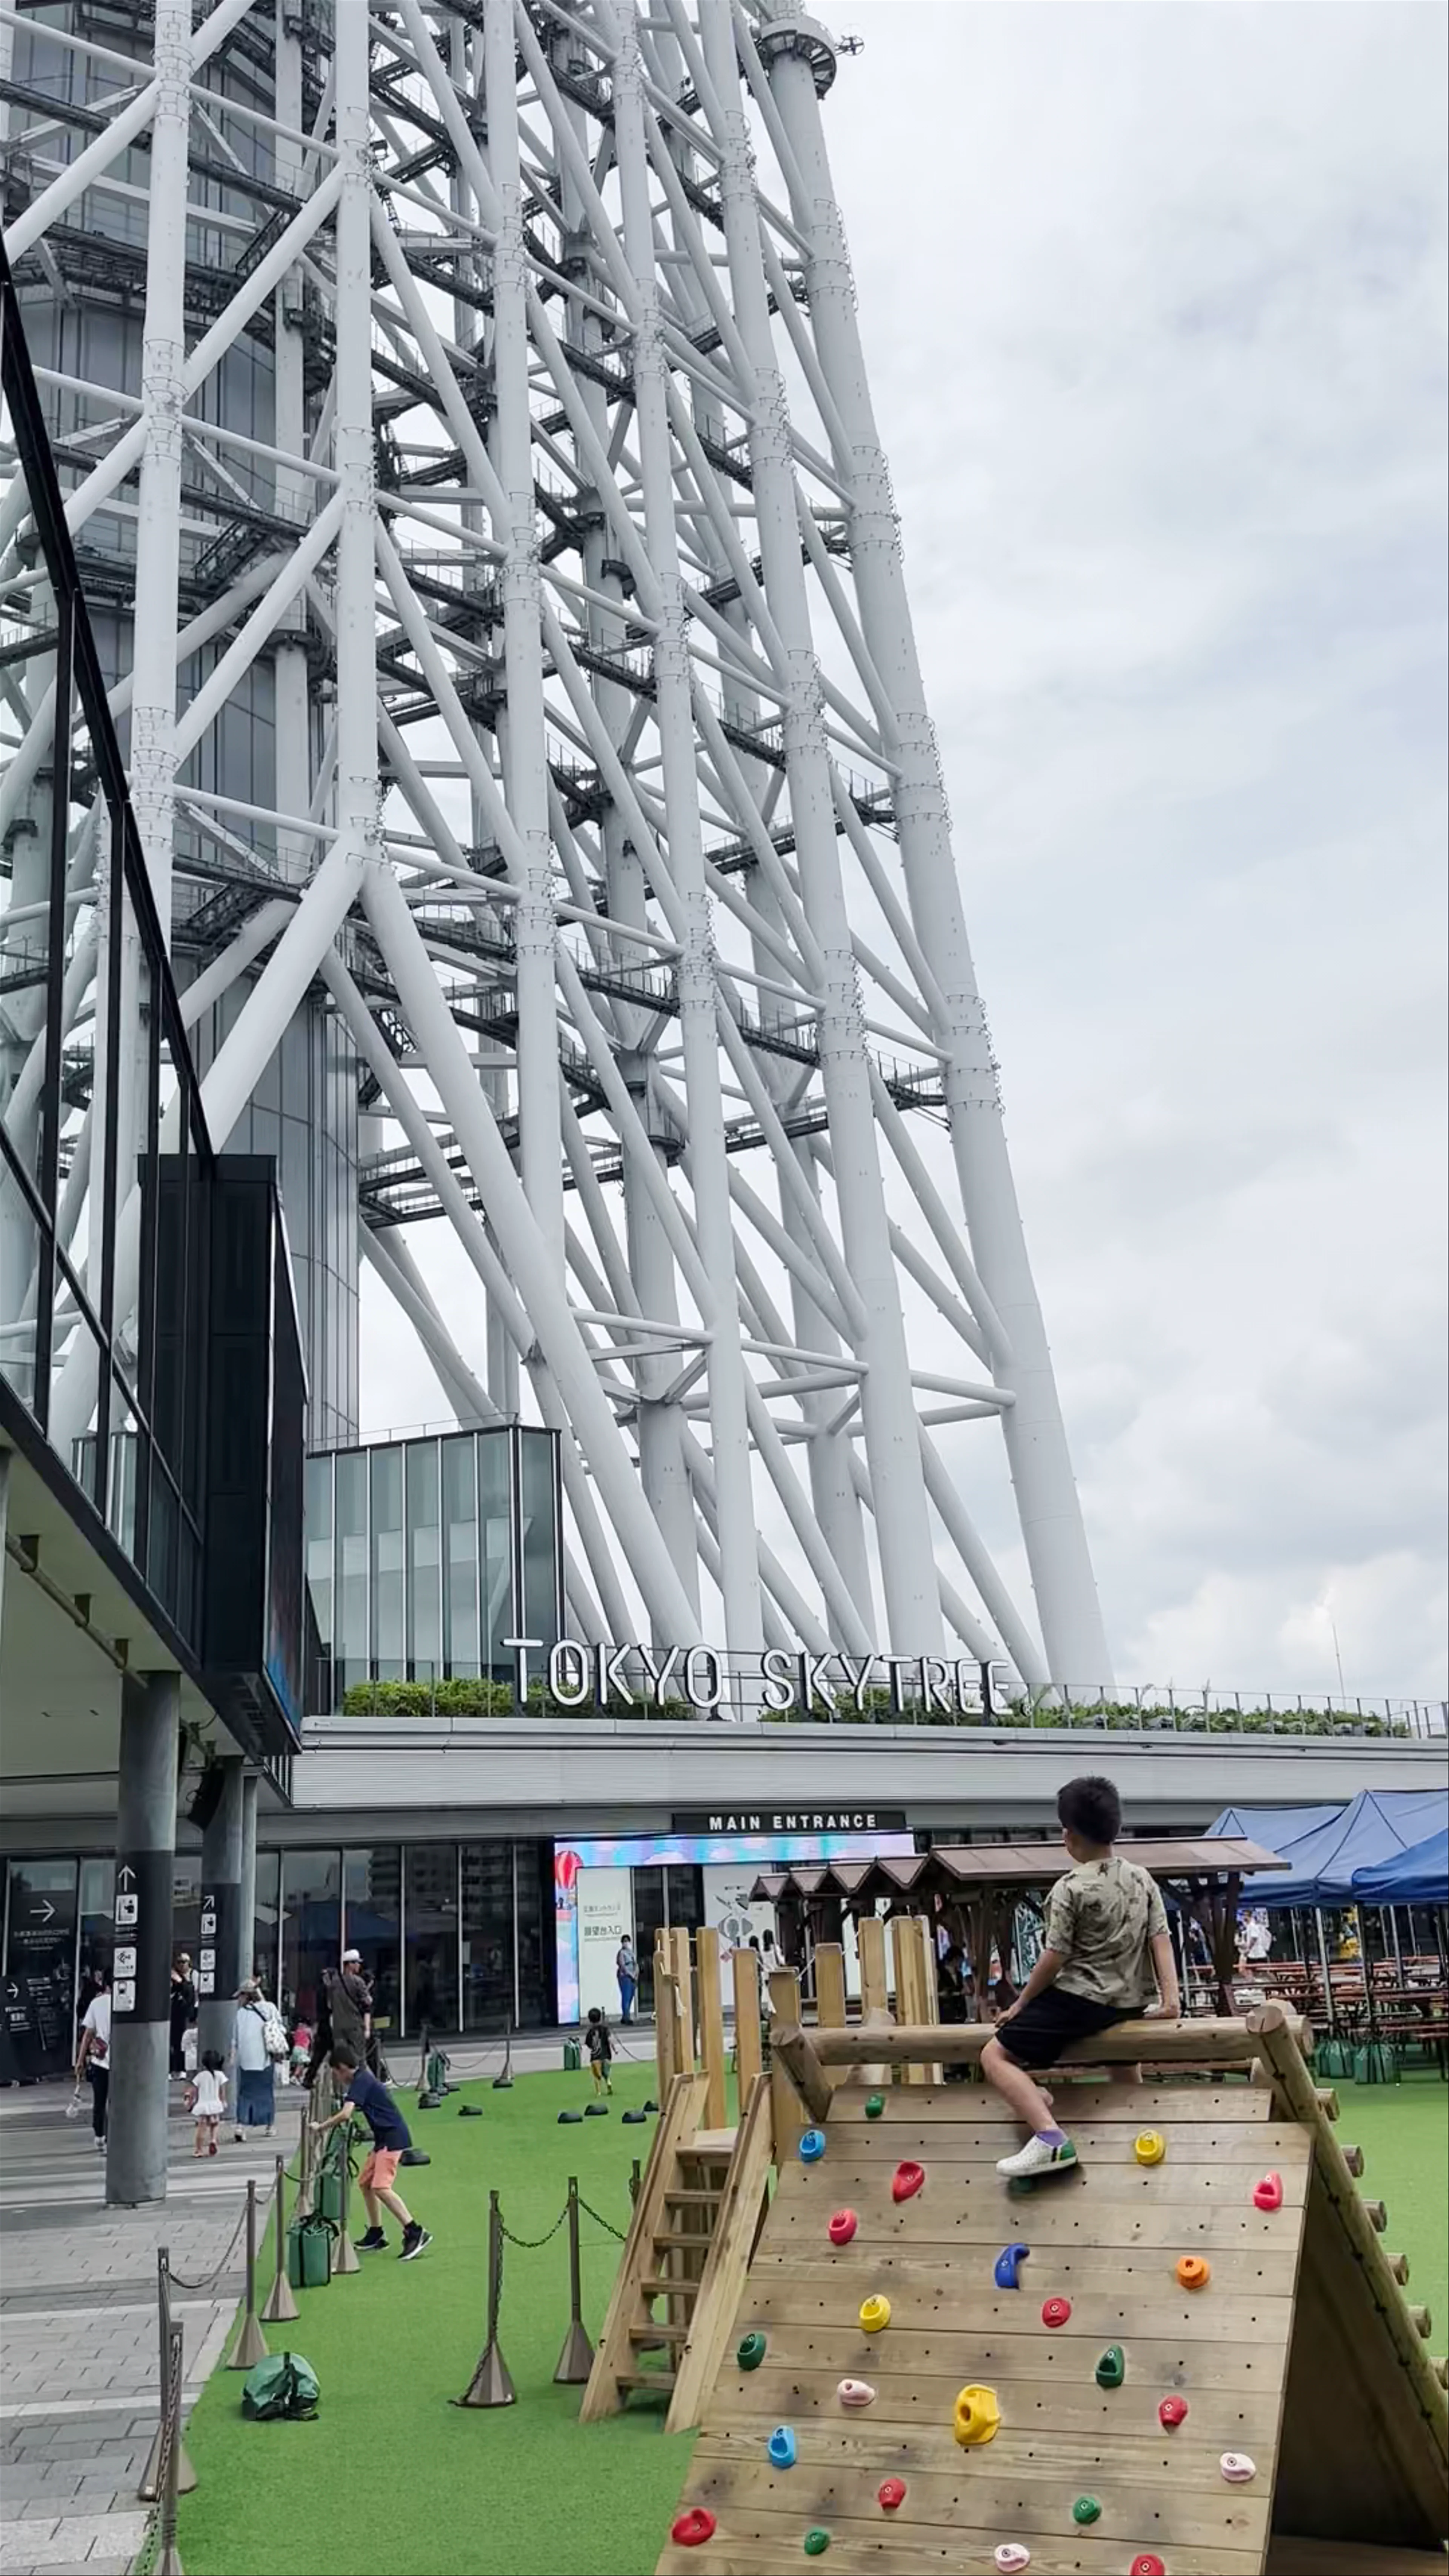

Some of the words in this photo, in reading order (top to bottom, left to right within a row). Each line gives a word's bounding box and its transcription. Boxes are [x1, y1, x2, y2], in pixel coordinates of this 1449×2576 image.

[501, 1638, 722, 1708] TOKYO
[762, 1649, 1013, 1715] SKYTREE
[709, 1816, 760, 1830] MAIN
[773, 1814, 876, 1829] ENTRANCE
